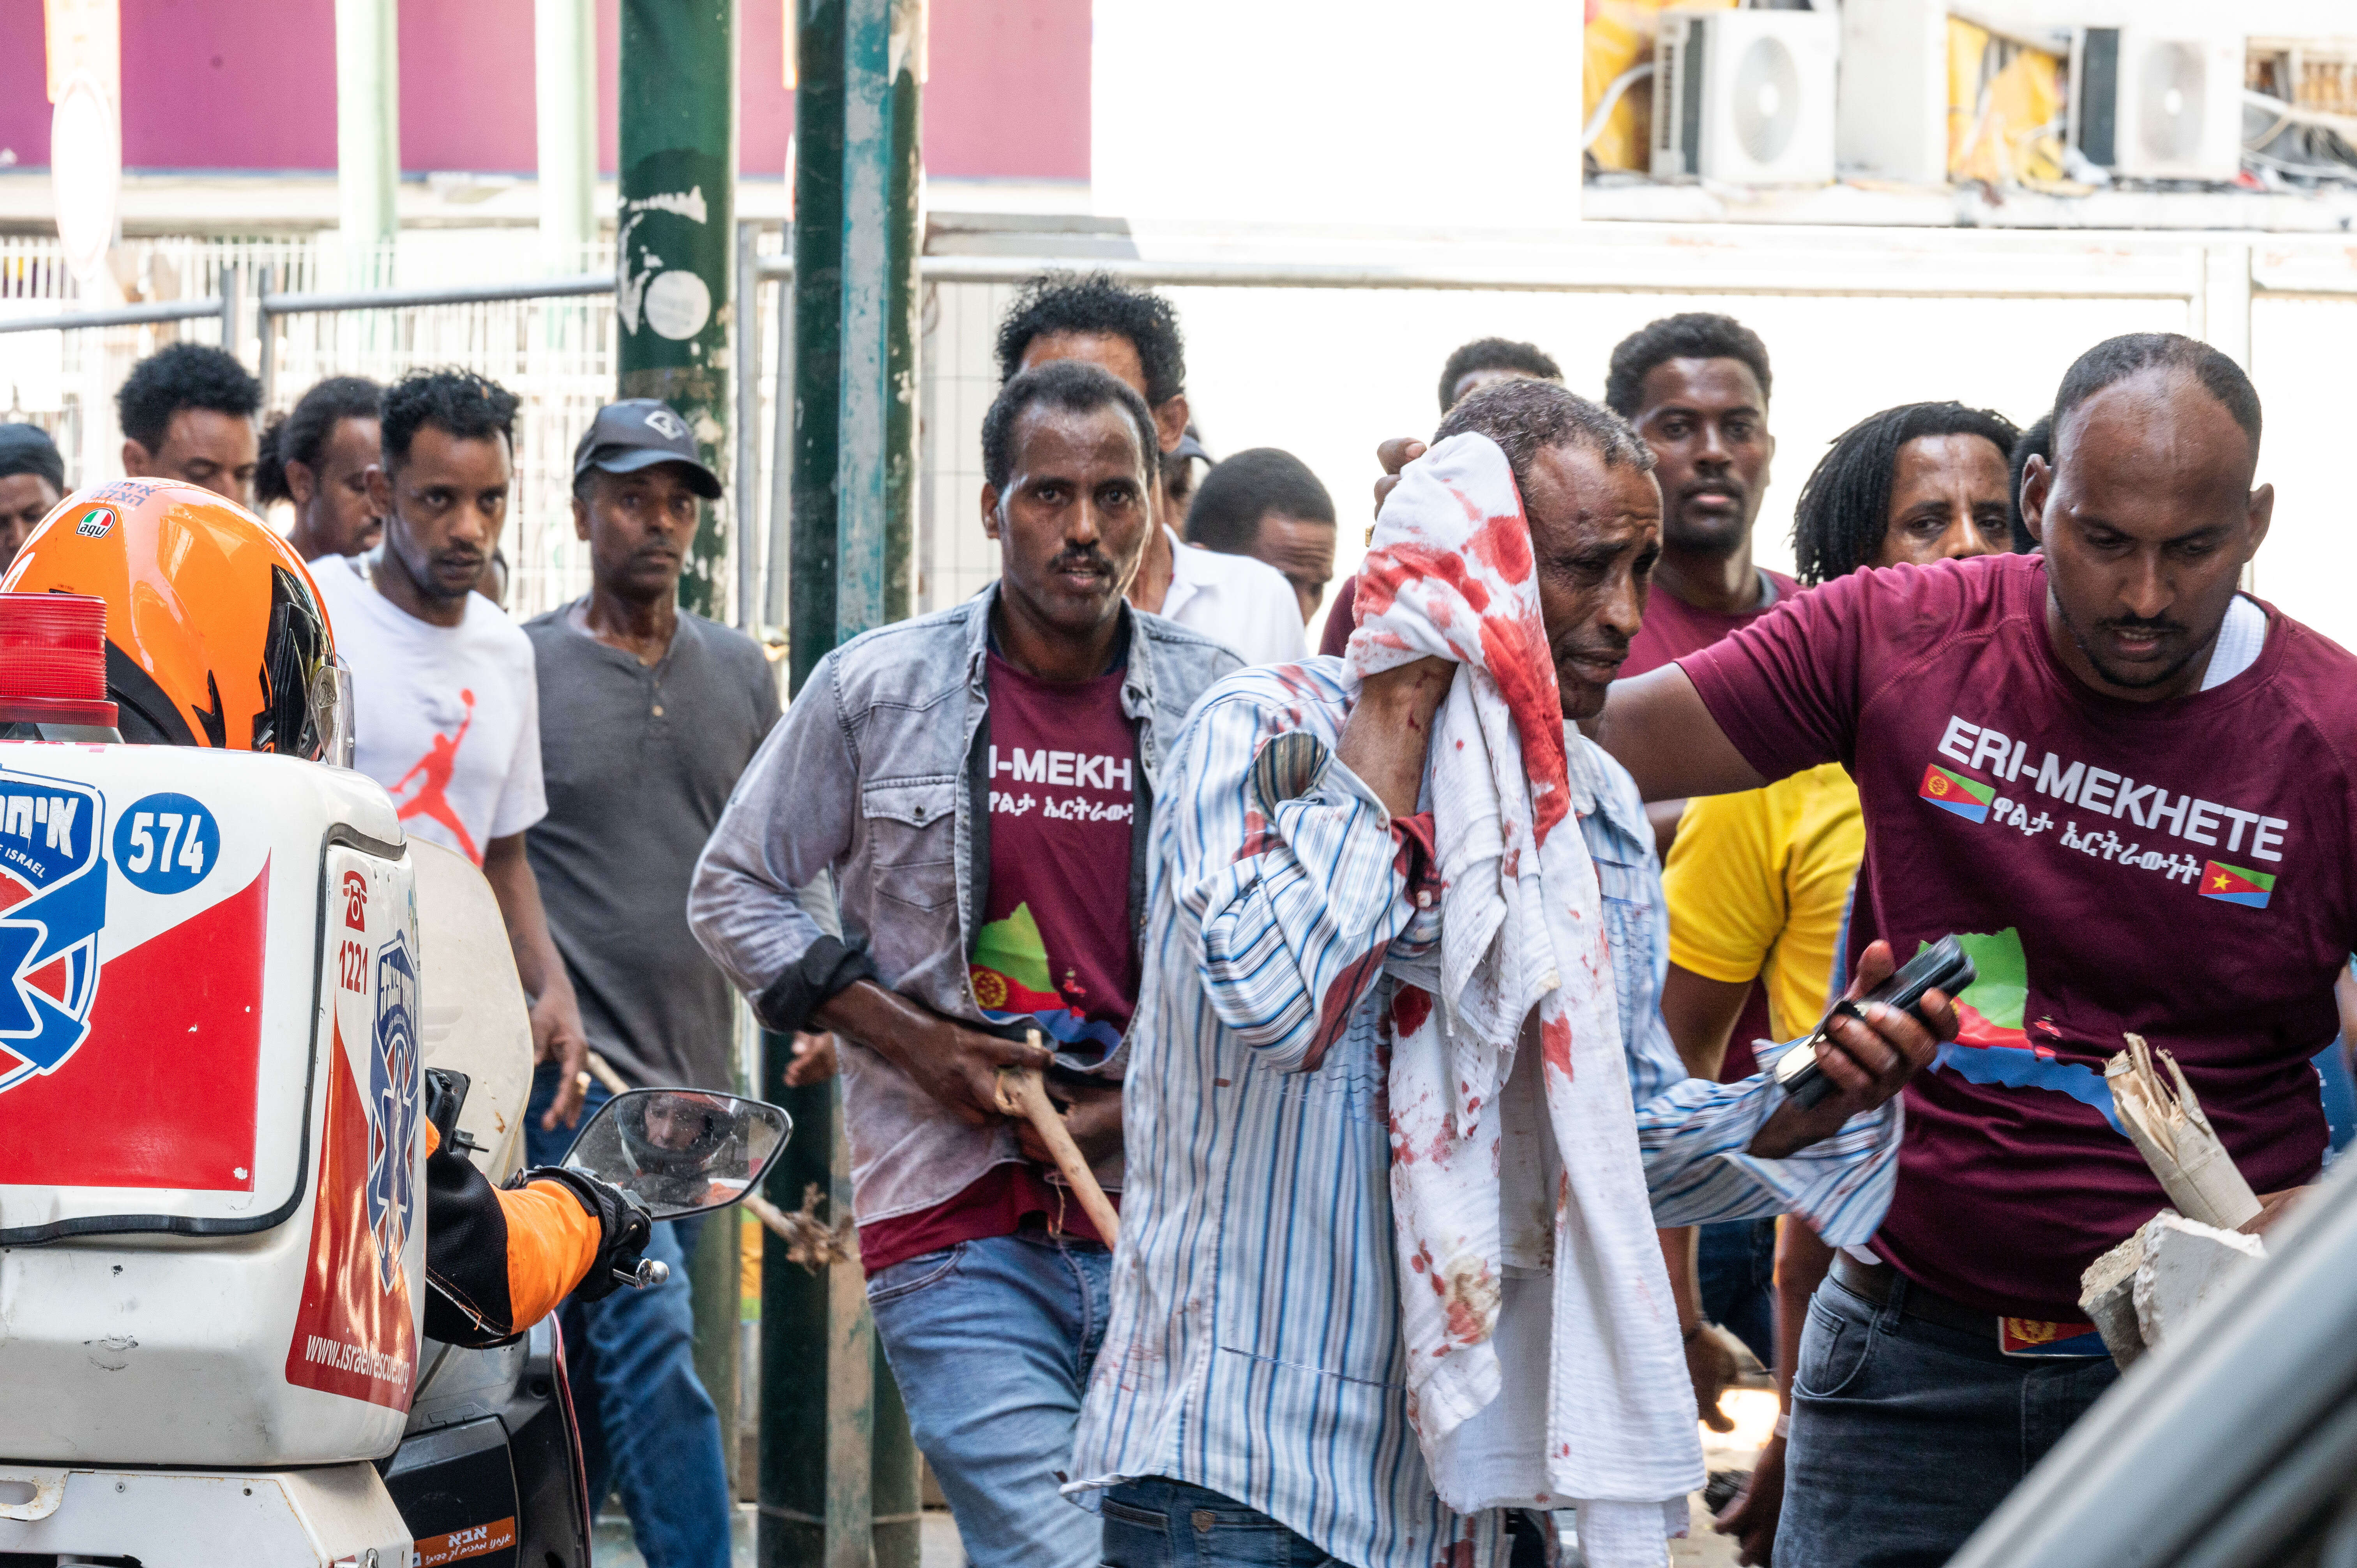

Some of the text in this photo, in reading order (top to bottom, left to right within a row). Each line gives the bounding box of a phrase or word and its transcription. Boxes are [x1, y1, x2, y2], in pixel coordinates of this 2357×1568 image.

[90, 489, 146, 507] הצלה
[80, 524, 106, 536] agv
[1937, 715, 2288, 862] ERI-MEKHETE
[5, 848, 45, 878] ISRAEL
[128, 812, 204, 874] 574
[339, 940, 368, 995] 1221
[380, 957, 401, 1022] הצלה
[306, 1328, 410, 1394] www.israelrescue.org
[449, 1526, 487, 1547] אבא
